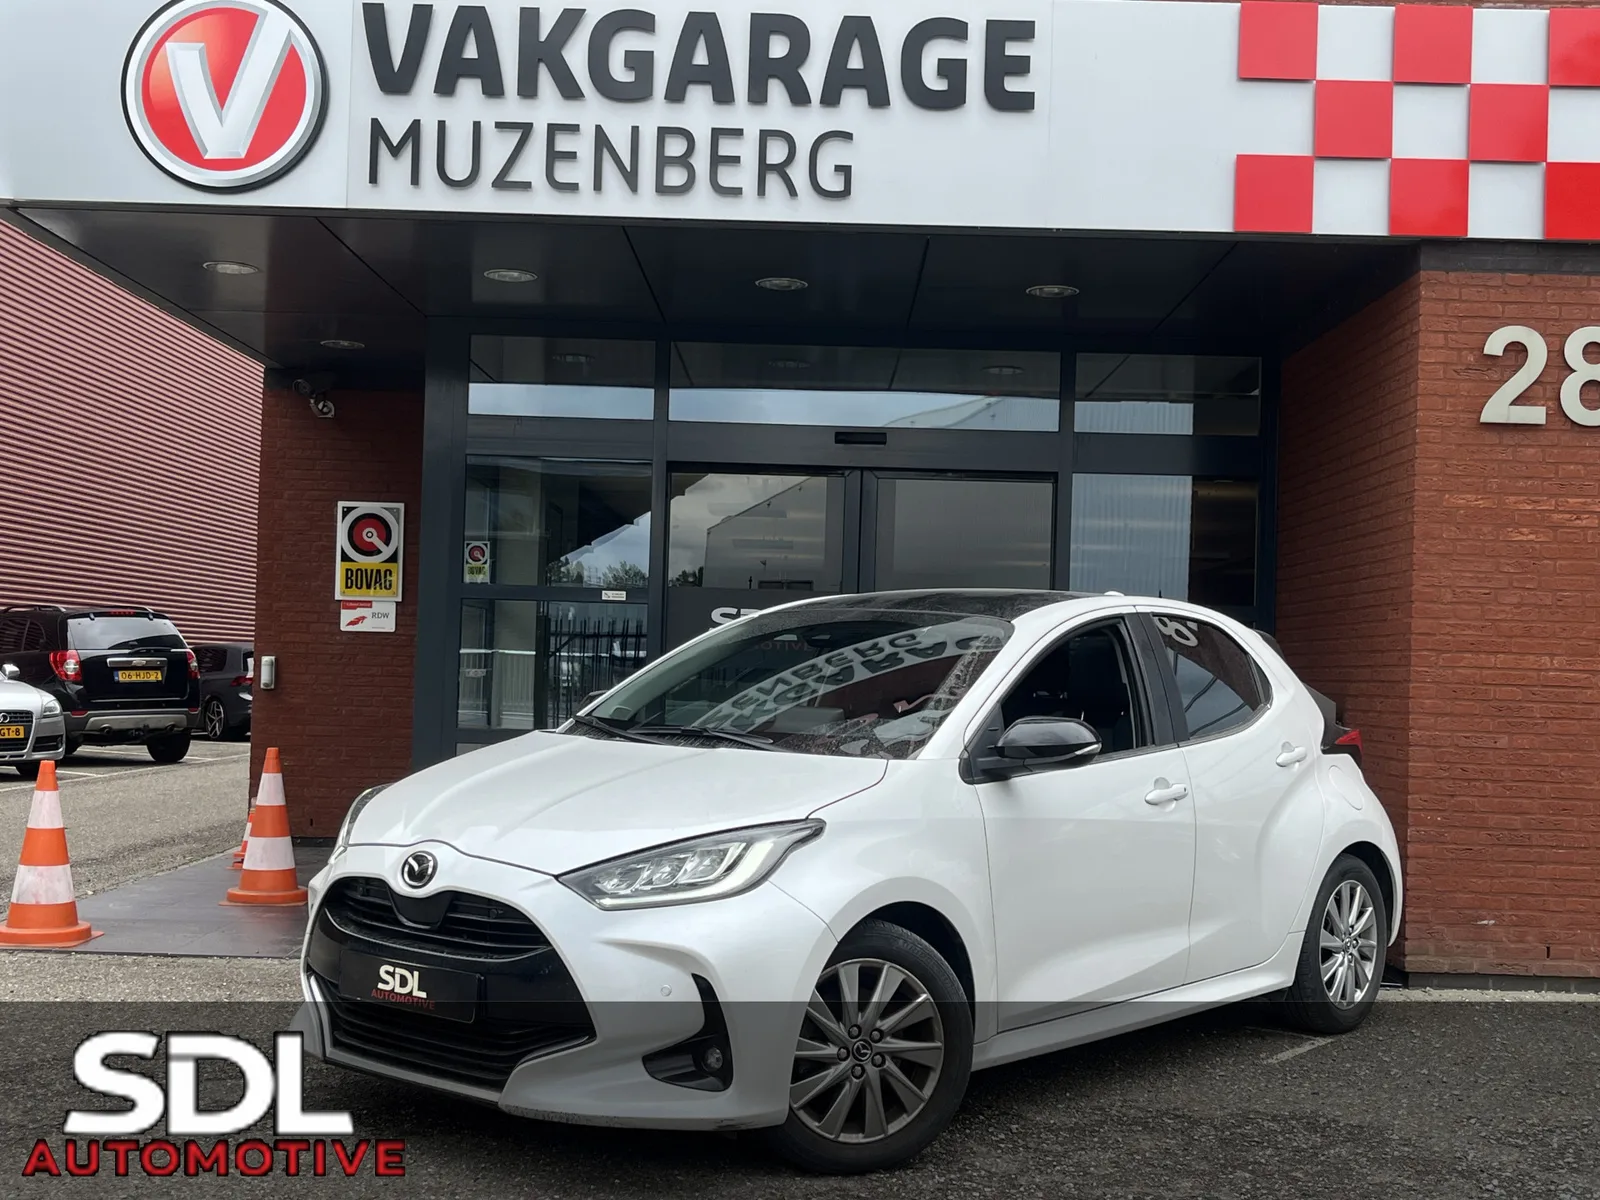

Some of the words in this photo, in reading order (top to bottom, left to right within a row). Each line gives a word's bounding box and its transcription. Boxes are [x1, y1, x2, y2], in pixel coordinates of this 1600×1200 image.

[362, 3, 1036, 112] VAKGARAGE
[369, 117, 854, 199] MUZENBERG
[1479, 325, 1600, 427] 28
[344, 568, 393, 591] BOVAG
[371, 988, 436, 1011] AUTOMOTIVE
[377, 964, 428, 999] SDL
